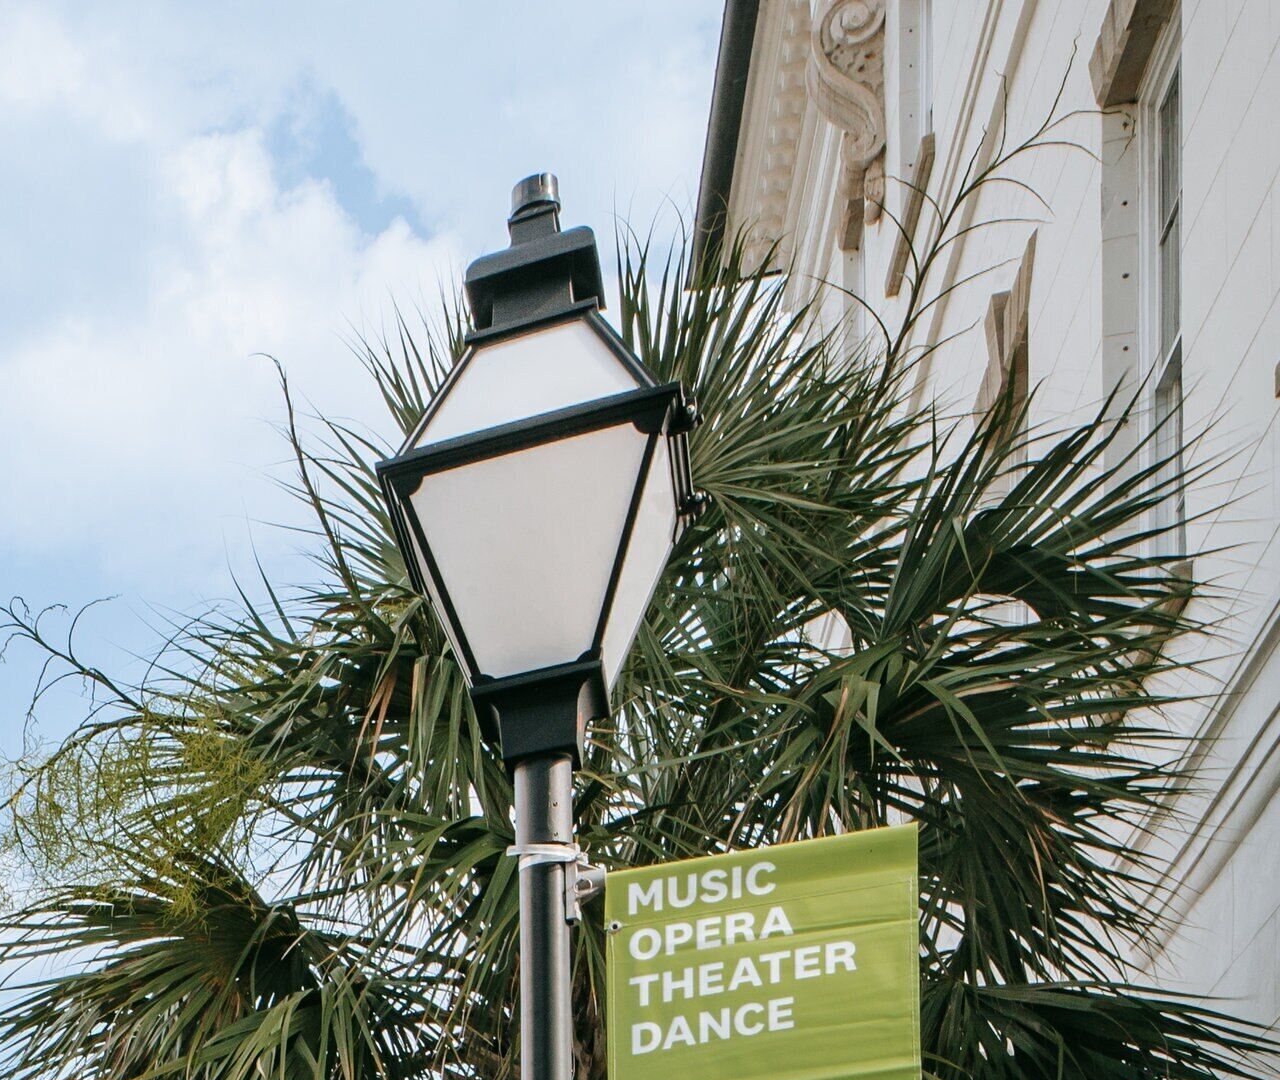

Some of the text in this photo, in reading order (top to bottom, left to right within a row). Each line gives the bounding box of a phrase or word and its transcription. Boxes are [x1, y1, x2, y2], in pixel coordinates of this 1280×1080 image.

[628, 862, 776, 915] MUSIC
[629, 906, 794, 961] OPERA
[629, 941, 857, 1006] THEATER
[631, 997, 795, 1056] DANCE
